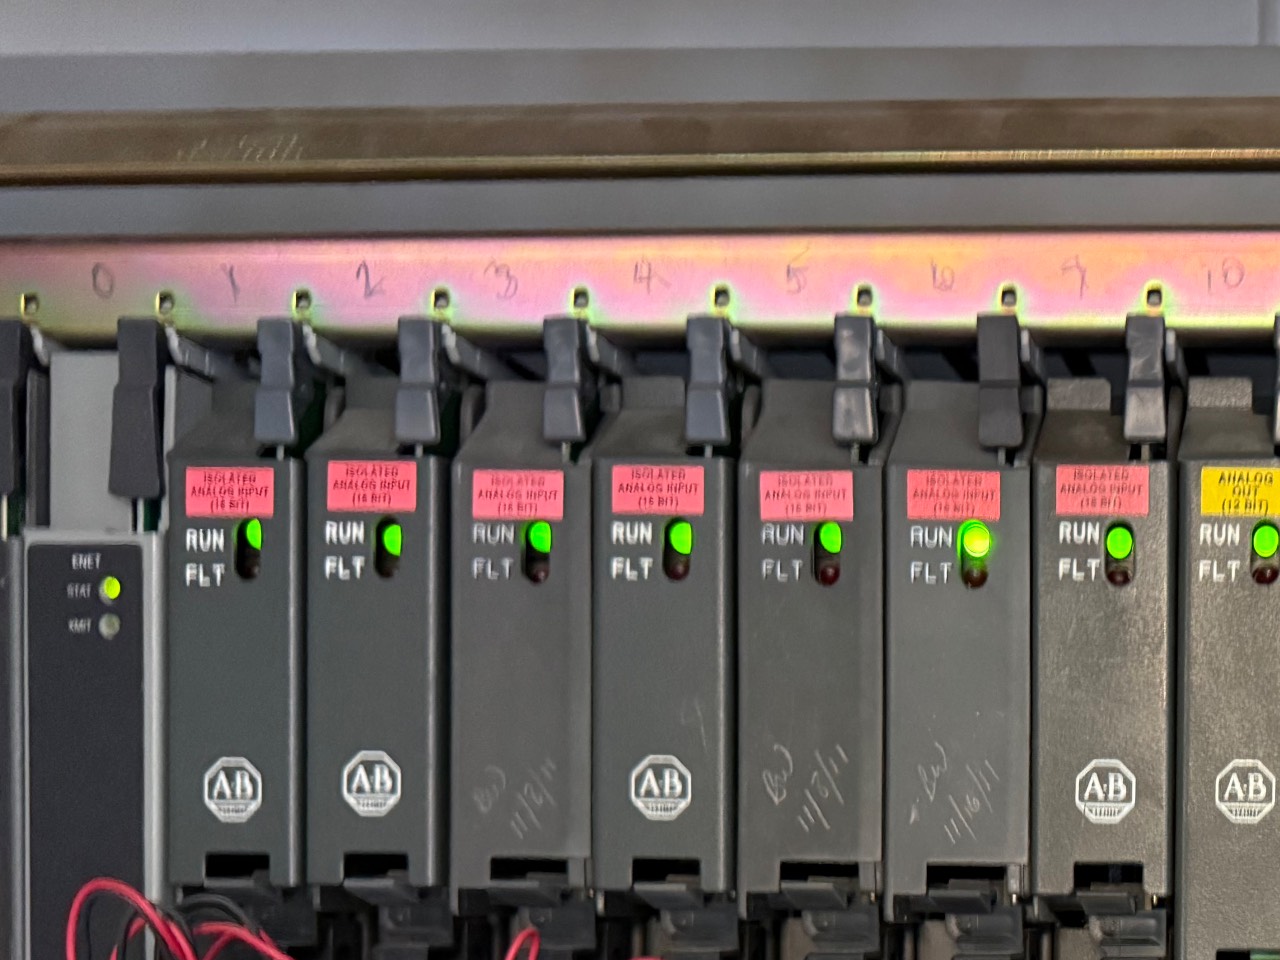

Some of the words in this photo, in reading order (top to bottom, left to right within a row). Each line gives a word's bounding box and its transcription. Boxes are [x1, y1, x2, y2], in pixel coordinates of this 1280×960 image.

[334, 479, 376, 490] ANALOG
[380, 480, 410, 491] INPUT
[618, 482, 661, 494] ANALOG
[666, 483, 698, 494] INPUT
[1218, 471, 1273, 485] ANALOG
[191, 485, 233, 497] ANALOG
[238, 486, 269, 497] INPUT
[478, 489, 521, 500] ANALOG
[526, 490, 557, 500] INPUT
[764, 489, 810, 500] ANALOG
[814, 490, 846, 500] INPUT
[912, 489, 957, 499] ANALOG
[962, 489, 995, 500] INPUT
[1060, 484, 1106, 495] ANALOG
[1110, 484, 1142, 494] INPUT
[1232, 486, 1258, 498] OUT
[1222, 498, 1240, 514] (12
[1244, 498, 1269, 515] BIT)
[186, 528, 224, 552] RUN
[325, 521, 364, 544] RUN
[473, 523, 514, 544] RUN
[612, 521, 652, 544] RUN
[762, 523, 804, 545] RUN
[911, 526, 952, 548] RUN
[1059, 521, 1100, 544] RUN
[1200, 524, 1240, 546] RUN
[186, 563, 225, 587] FLT
[325, 555, 365, 580] FLT
[473, 557, 512, 580] FLT
[612, 556, 653, 581] FLT
[762, 559, 803, 582] FLT
[910, 562, 952, 584] FLT
[1059, 558, 1100, 581] FLT
[1199, 560, 1240, 584] FLT
